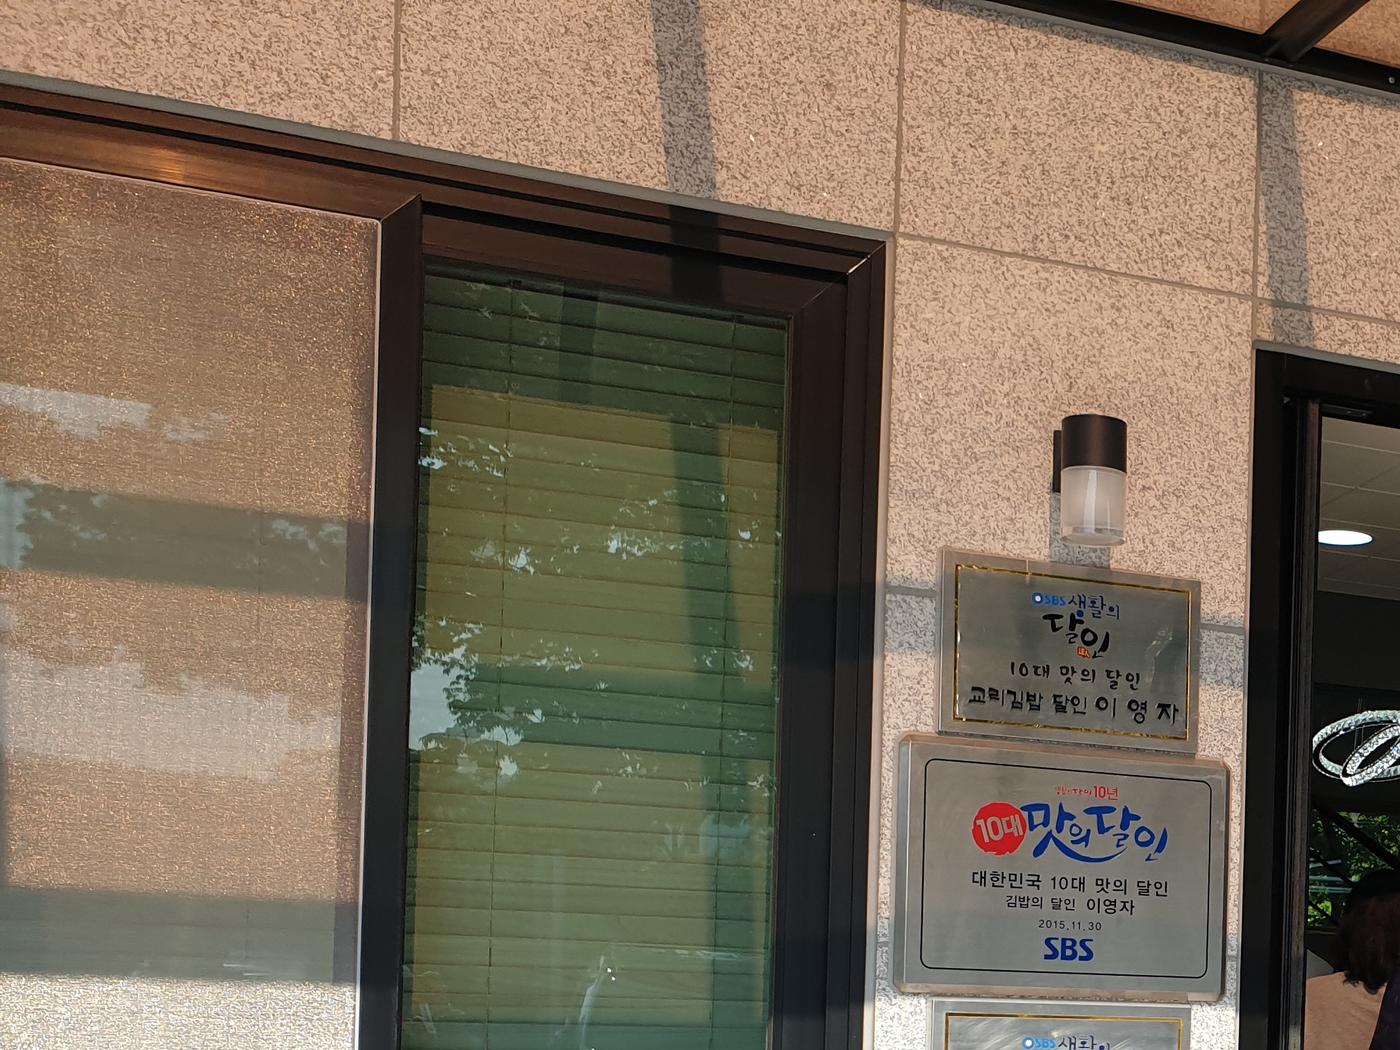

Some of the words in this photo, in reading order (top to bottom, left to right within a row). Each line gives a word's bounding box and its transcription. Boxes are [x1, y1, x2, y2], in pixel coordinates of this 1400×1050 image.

[1068, 592, 1120, 620] 생활의
[1042, 612, 1110, 659] 달인
[1010, 662, 1050, 678] 10대
[1060, 666, 1095, 685] 맛의
[1105, 668, 1140, 691] 달인
[968, 686, 1043, 711] 교리김밥
[1051, 694, 1087, 715] 달인
[1093, 785, 1119, 800] 10년
[975, 815, 1023, 843] 10대
[971, 870, 1042, 891] 대한민국
[1050, 875, 1085, 892] 10대
[1095, 876, 1128, 897] 맛의
[1136, 878, 1169, 898] 달인
[1006, 894, 1044, 910] 김밥의
[1050, 896, 1076, 912] 달인
[1086, 897, 1135, 916] 이영자
[1038, 919, 1102, 931] 2015.11.30
[1044, 937, 1094, 961] SBS
